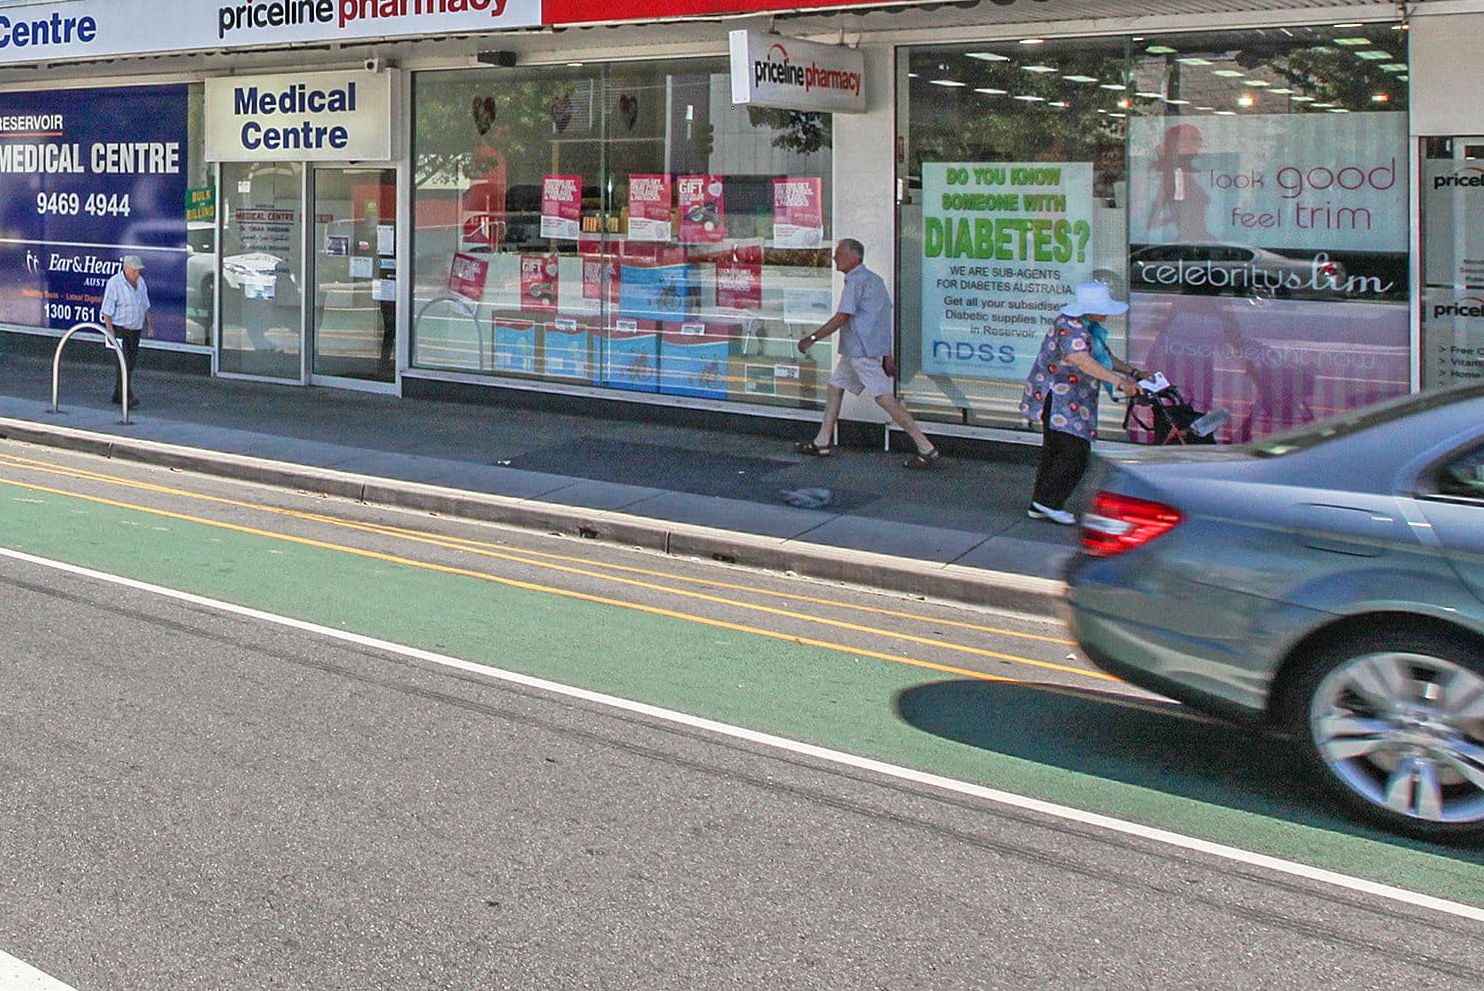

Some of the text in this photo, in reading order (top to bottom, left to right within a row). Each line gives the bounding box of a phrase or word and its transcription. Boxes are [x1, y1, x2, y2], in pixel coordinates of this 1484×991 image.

[755, 54, 861, 96] priceline pharmacy
[234, 82, 356, 115] Medical
[241, 121, 348, 150] Centre
[91, 142, 180, 174] CENTRE
[947, 167, 1061, 186] DO YOU KNOW
[1210, 158, 1396, 198] look good
[679, 182, 703, 194] GIFT
[37, 192, 131, 217] 9469 4944
[942, 193, 1066, 211] SOMEONE WITH
[268, 212, 294, 222] CENTRE
[1232, 201, 1371, 229] feel trim
[925, 216, 1091, 263] DIABETES?
[48, 253, 124, 275] Ear&Heari
[950, 266, 1060, 279] WE ARE SUB-AGENTS
[84, 277, 107, 287] AUST
[937, 279, 1076, 295] FOR DIABETES AUSTRALIA.
[944, 296, 963, 306] Get
[966, 297, 977, 307] all
[981, 300, 1004, 309] your
[44, 303, 71, 320] 1300
[74, 306, 95, 322] 761
[946, 310, 1055, 326] Diabetic supplies he
[970, 325, 980, 334] in
